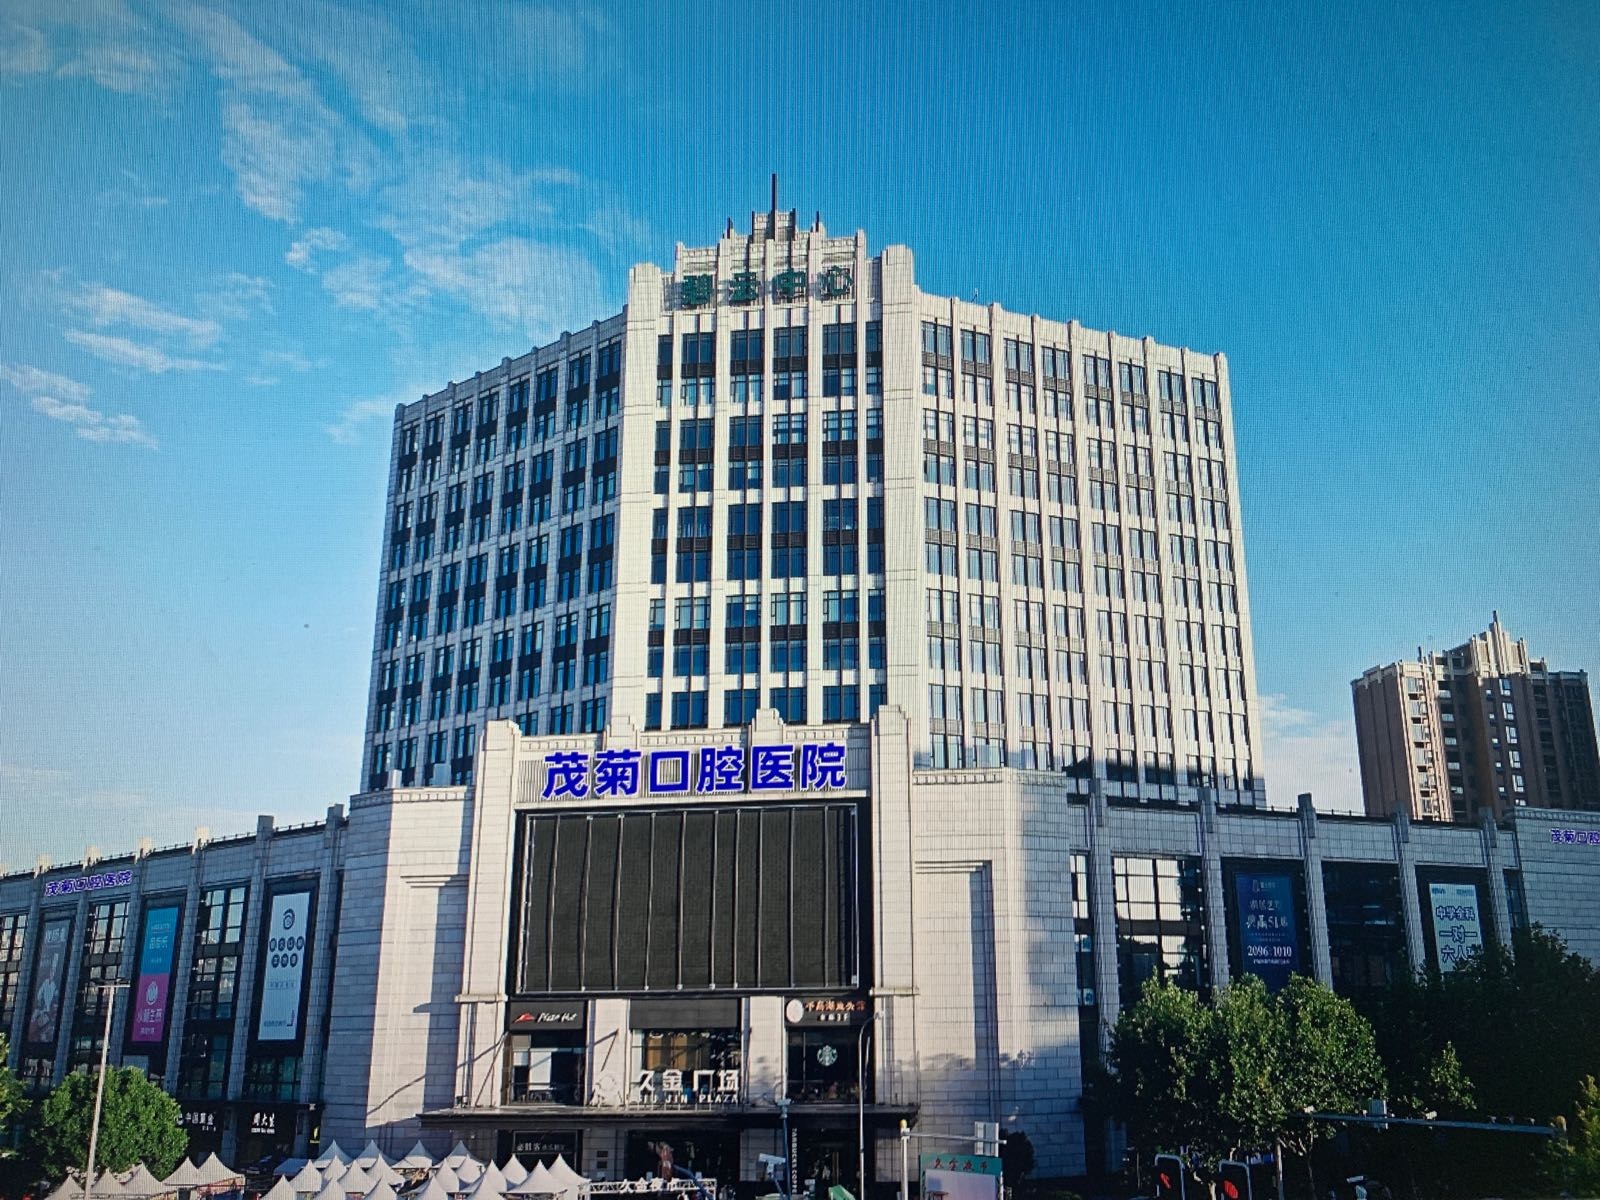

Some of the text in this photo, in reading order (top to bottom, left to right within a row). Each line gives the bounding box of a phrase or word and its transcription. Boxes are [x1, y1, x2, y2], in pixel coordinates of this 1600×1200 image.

[542, 743, 847, 798] 茂菊口腔医院
[1439, 925, 1477, 944] 一对一
[638, 1069, 739, 1092] 久金广场
[666, 1095, 688, 1104] JIN
[699, 1095, 739, 1104] PLAZA
